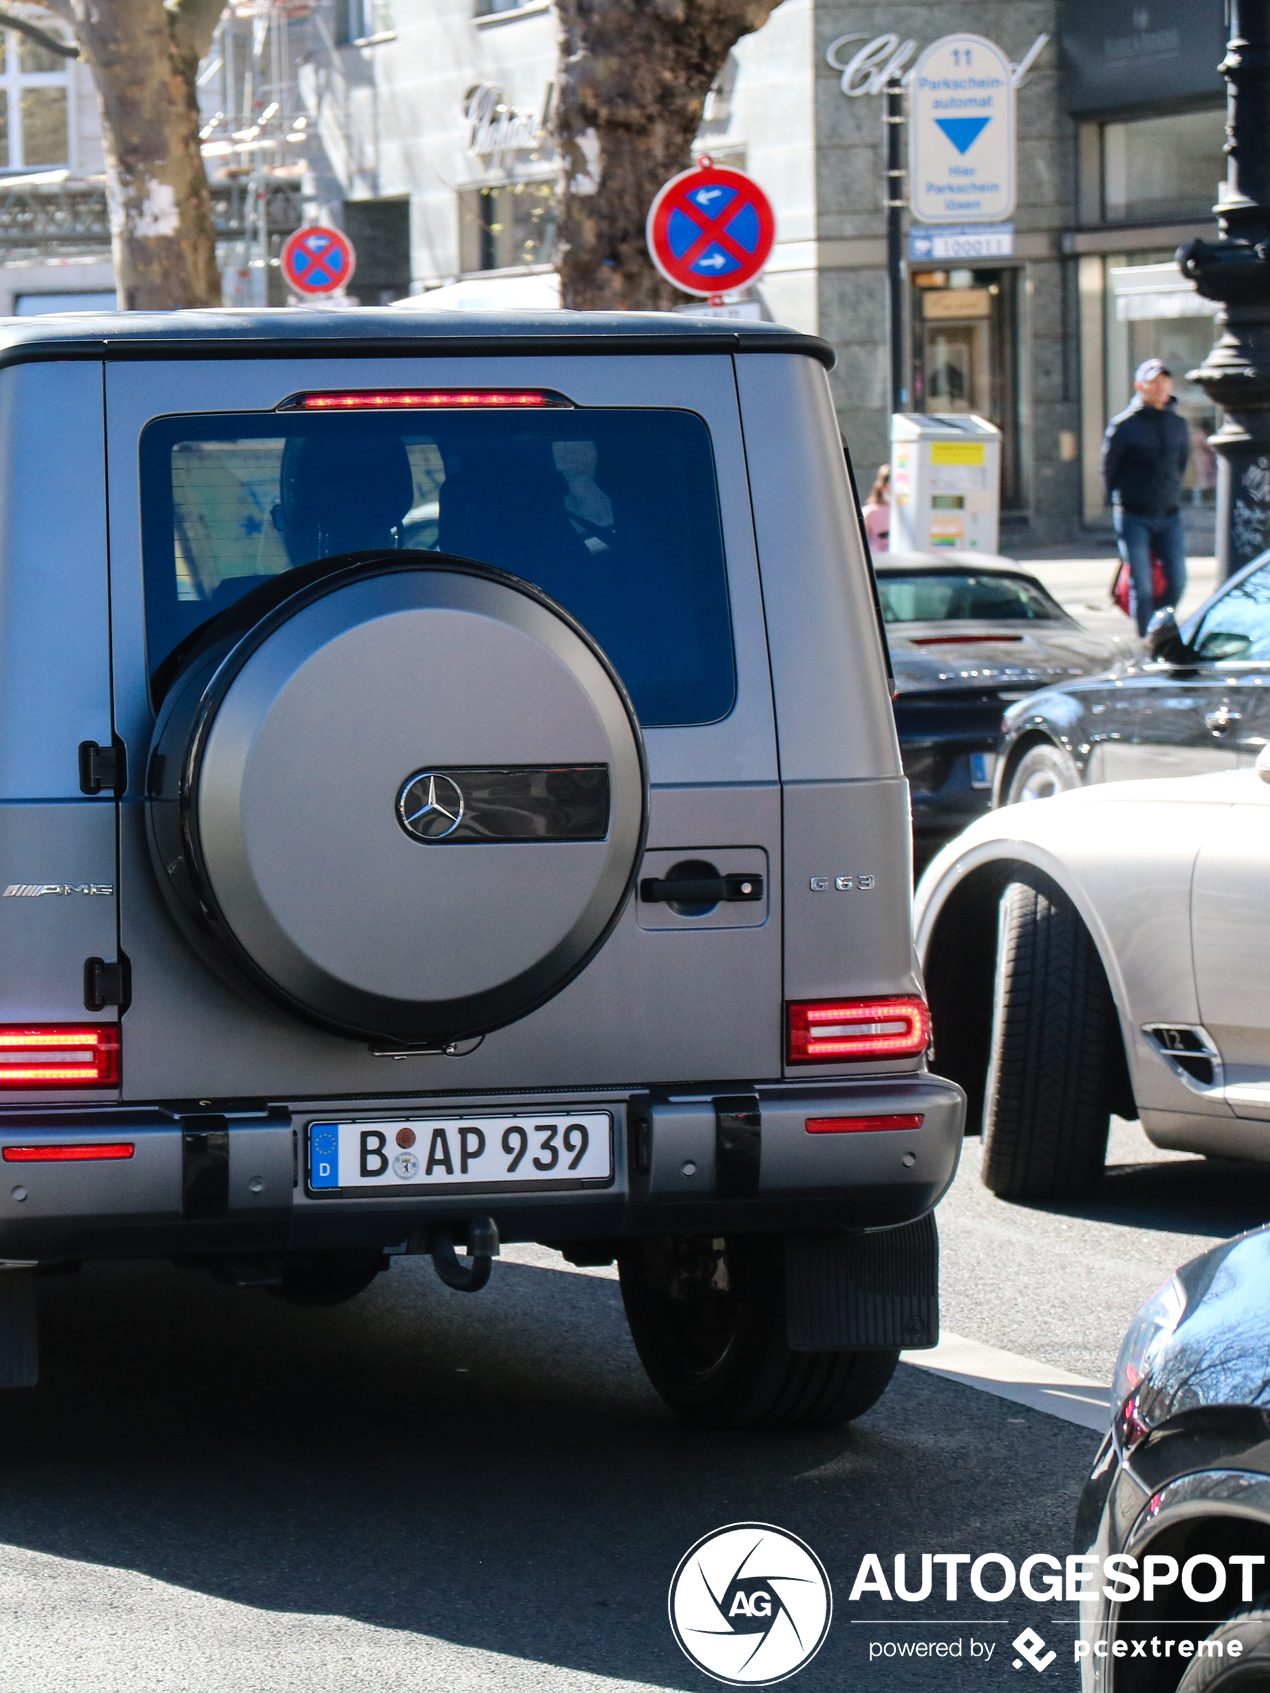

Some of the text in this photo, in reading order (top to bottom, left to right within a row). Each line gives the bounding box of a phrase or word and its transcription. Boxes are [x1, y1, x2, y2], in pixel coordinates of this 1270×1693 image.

[952, 47, 973, 66] 11
[932, 95, 993, 110] automat
[948, 165, 976, 177] Hier
[926, 181, 1000, 195] Parkschein
[36, 883, 113, 897] AMG
[810, 874, 875, 892] G 63
[319, 1123, 590, 1178] D B AP 939
